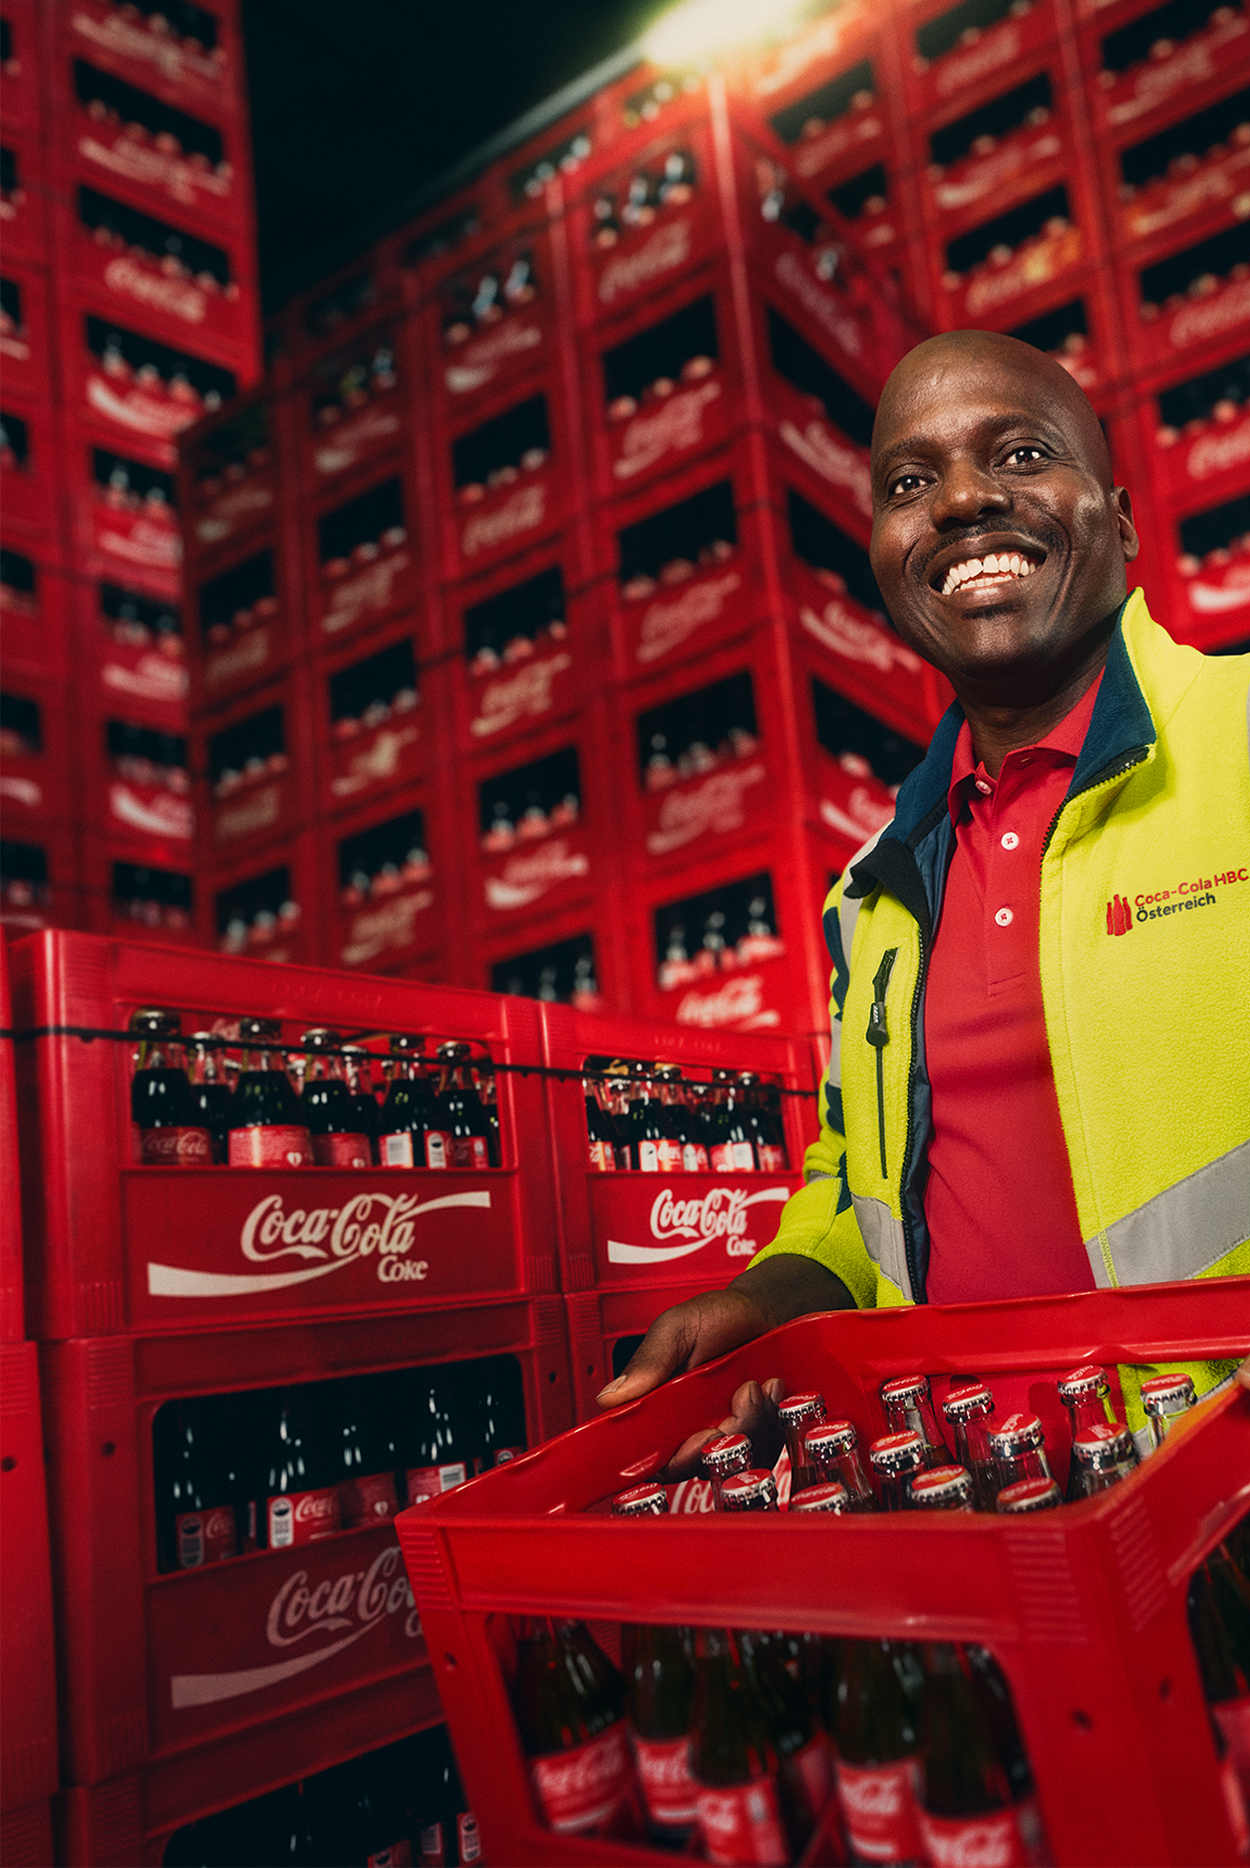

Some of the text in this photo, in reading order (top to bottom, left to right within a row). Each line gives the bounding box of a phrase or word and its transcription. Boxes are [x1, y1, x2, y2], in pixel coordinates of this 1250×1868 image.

[1134, 867, 1249, 907] Coca-Cola HBC
[1136, 892, 1216, 922] Österreich
[240, 1193, 418, 1263] Coca-Cola
[650, 1188, 748, 1240] Coca-Cola
[377, 1255, 429, 1283] Coke
[266, 1546, 418, 1647] Coca-Co
